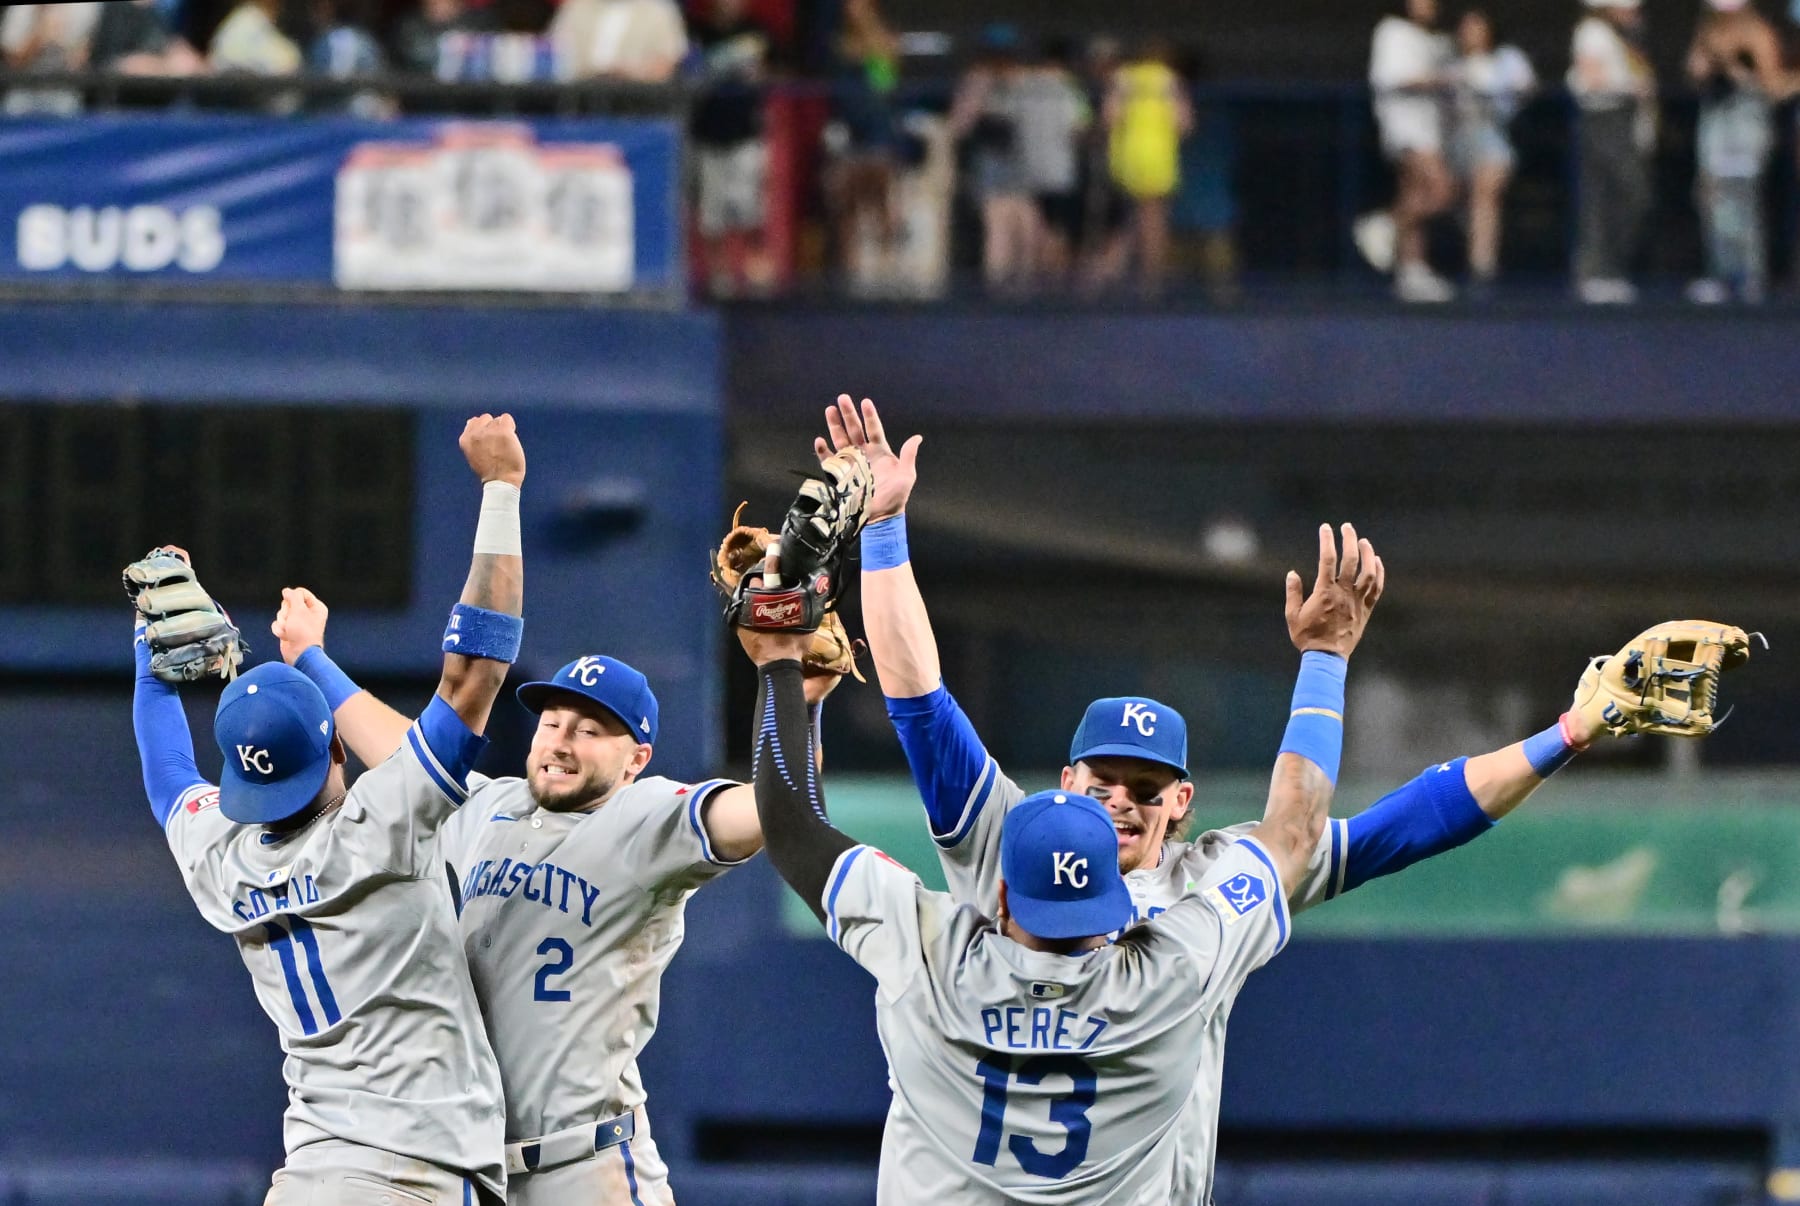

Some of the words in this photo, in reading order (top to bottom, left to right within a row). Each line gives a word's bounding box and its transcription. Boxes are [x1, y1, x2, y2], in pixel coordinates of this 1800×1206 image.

[17, 205, 226, 272] BUDS
[568, 656, 606, 687] KC
[1121, 703, 1157, 736] KC
[236, 744, 274, 775] KC
[1052, 852, 1089, 889] KC
[461, 858, 532, 912] ANSAS
[523, 862, 600, 928] CITY
[1226, 875, 1260, 913] KC
[262, 913, 342, 1036] 11
[534, 937, 573, 1002] 2
[981, 1006, 1108, 1050] PEREZ
[972, 1054, 1098, 1180] 13
